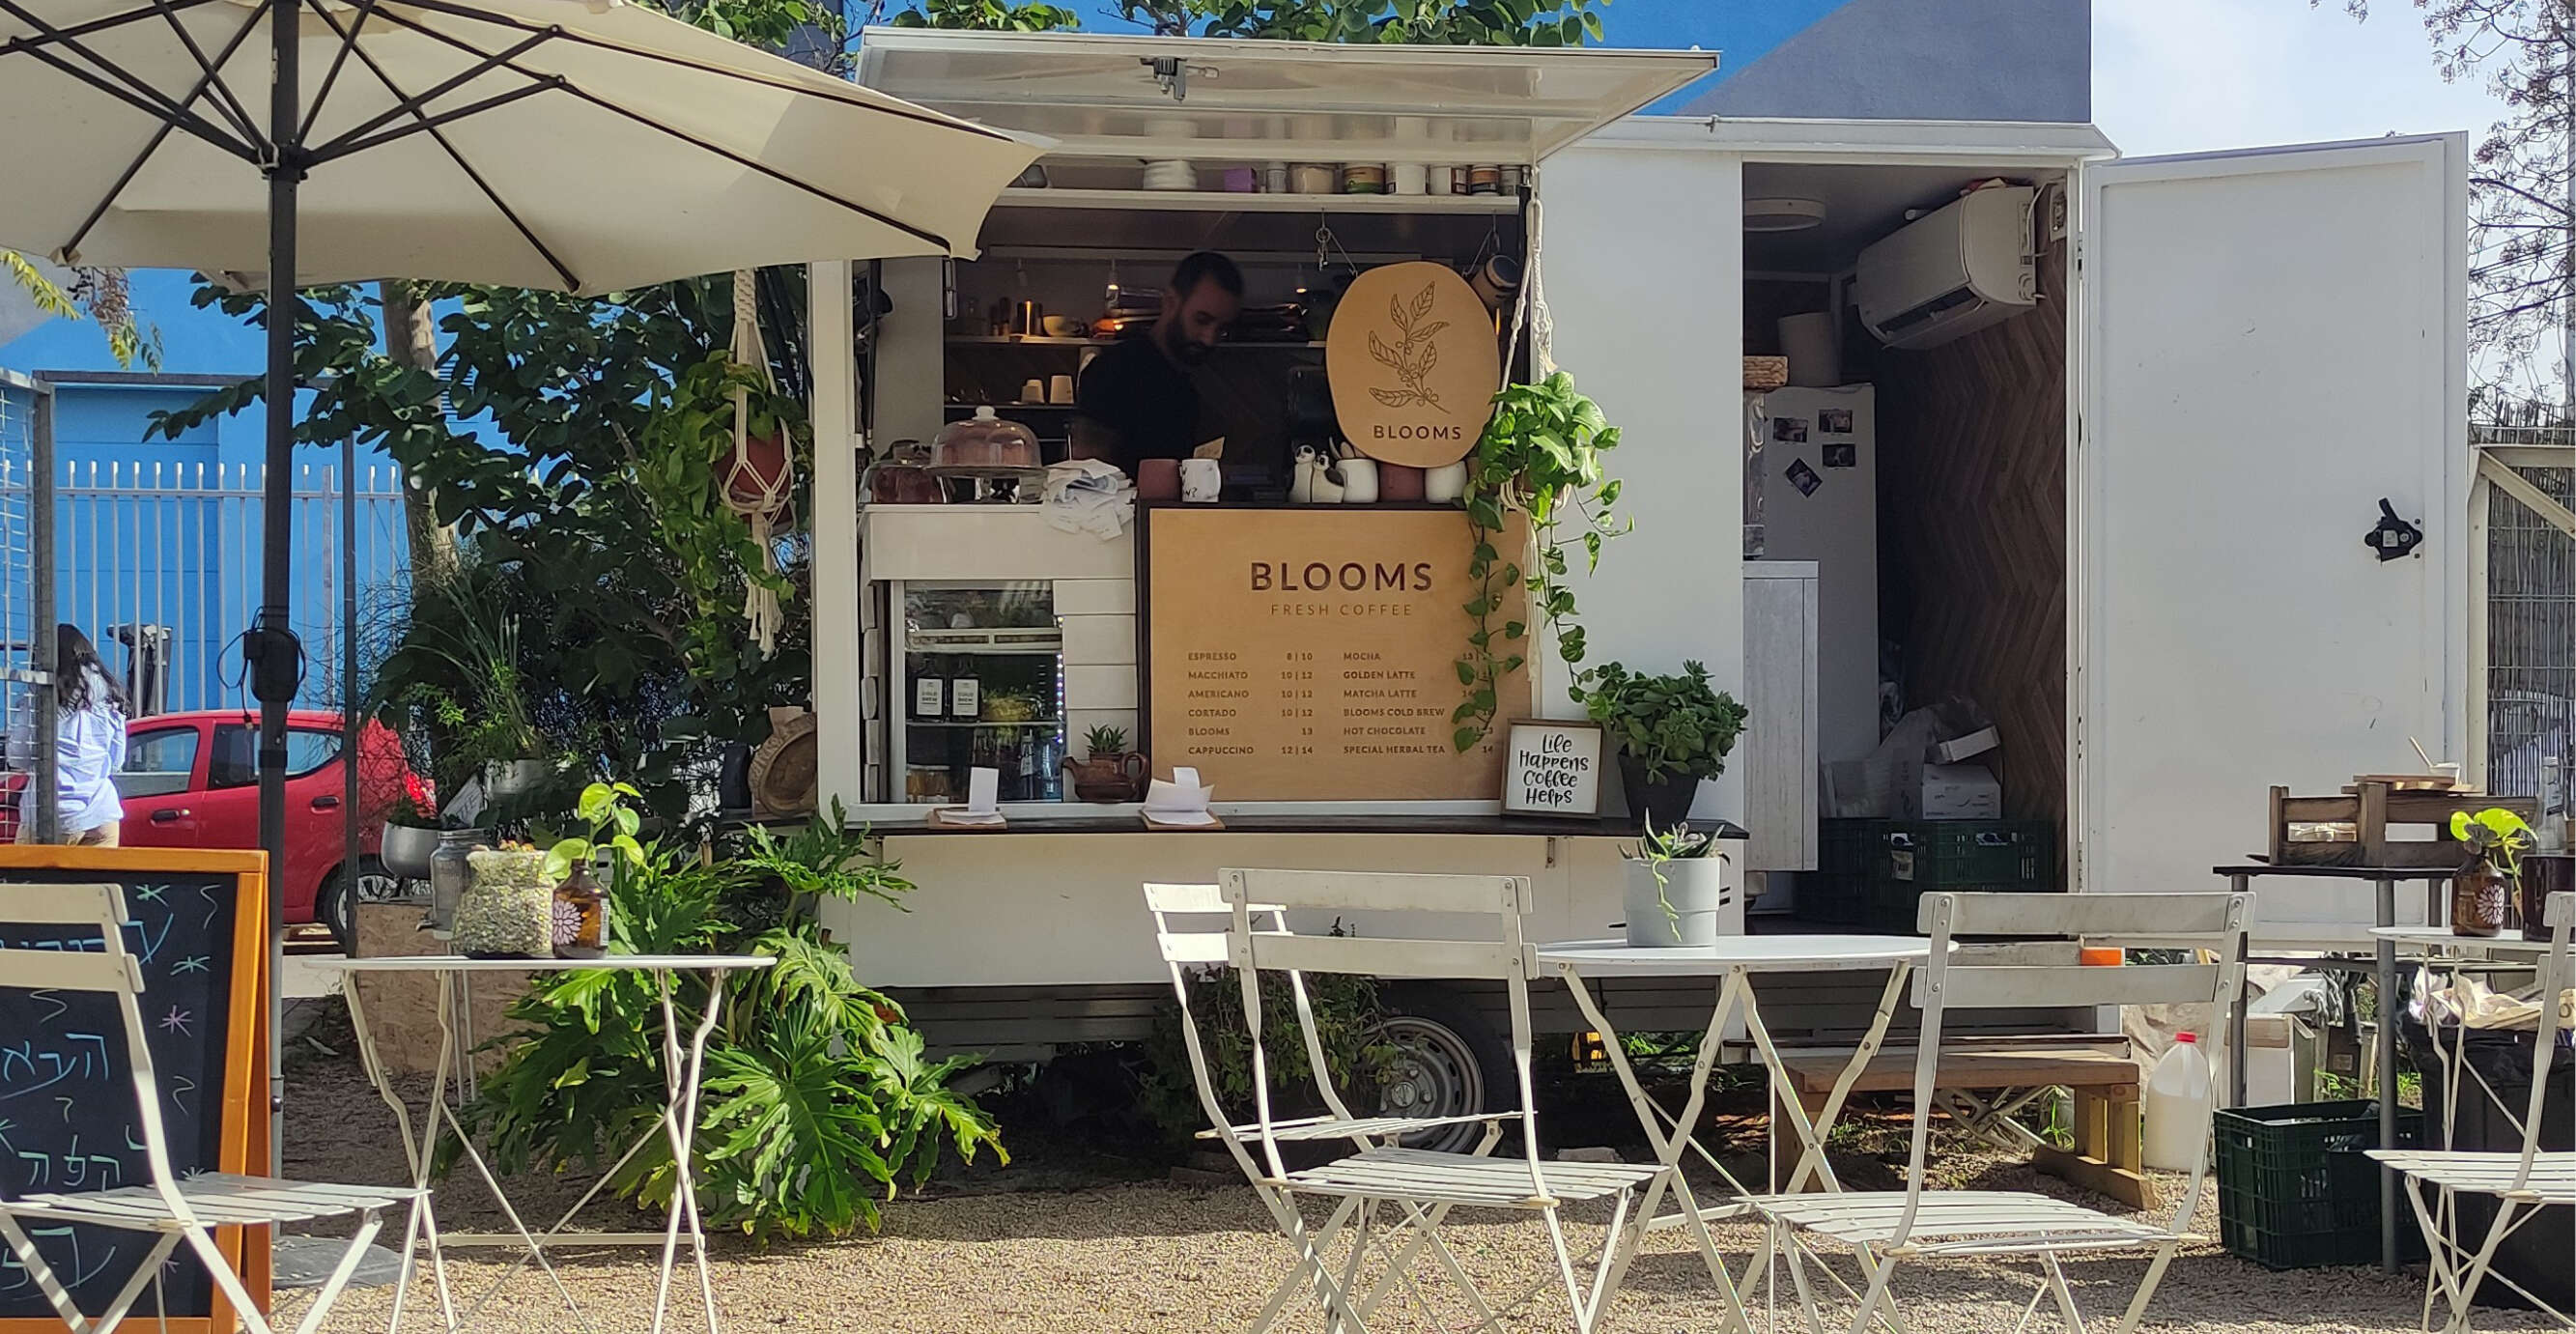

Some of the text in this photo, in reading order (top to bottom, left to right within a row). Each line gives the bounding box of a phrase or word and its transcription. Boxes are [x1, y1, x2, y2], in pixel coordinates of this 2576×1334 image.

[1373, 425, 1461, 440] BLOOMS
[1251, 561, 1432, 591] BLOOMS
[1271, 604, 1412, 616] FRESH COFFEE
[1187, 652, 1237, 662] ESPRESSO
[1301, 652, 1314, 661] 10
[1343, 652, 1381, 662] MOCHA
[1187, 670, 1249, 680] MACCHIATO
[1281, 670, 1292, 680] 10
[1301, 670, 1314, 680] 12
[1343, 670, 1384, 680] GOLDEN
[1386, 670, 1416, 680] LATTE
[1187, 690, 1250, 698] AMERICANO
[1281, 690, 1292, 698] 10
[1301, 690, 1314, 698] 12
[1343, 689, 1385, 698] MATCHA
[1387, 689, 1417, 698] LATTE
[1187, 708, 1237, 718] CORTADO
[1281, 708, 1292, 718] 10
[1301, 708, 1314, 718] 12
[1343, 707, 1445, 717] BLOOMS COLD BREW
[1187, 726, 1314, 736] BLOOMS 13
[1343, 726, 1365, 736] HOT
[1367, 726, 1426, 736] CHOCOLATE
[1542, 734, 1572, 753] Life
[1187, 746, 1254, 755] CAPPUCCINO
[1281, 746, 1293, 755] 12
[1301, 746, 1314, 755] 14
[1343, 745, 1384, 754] SPECIAL
[1385, 745, 1424, 754] HERBAL
[1426, 745, 1446, 754] TEA
[1519, 750, 1589, 771] Happens
[1523, 770, 1577, 788] Coffee
[1525, 787, 1572, 809] Helps
